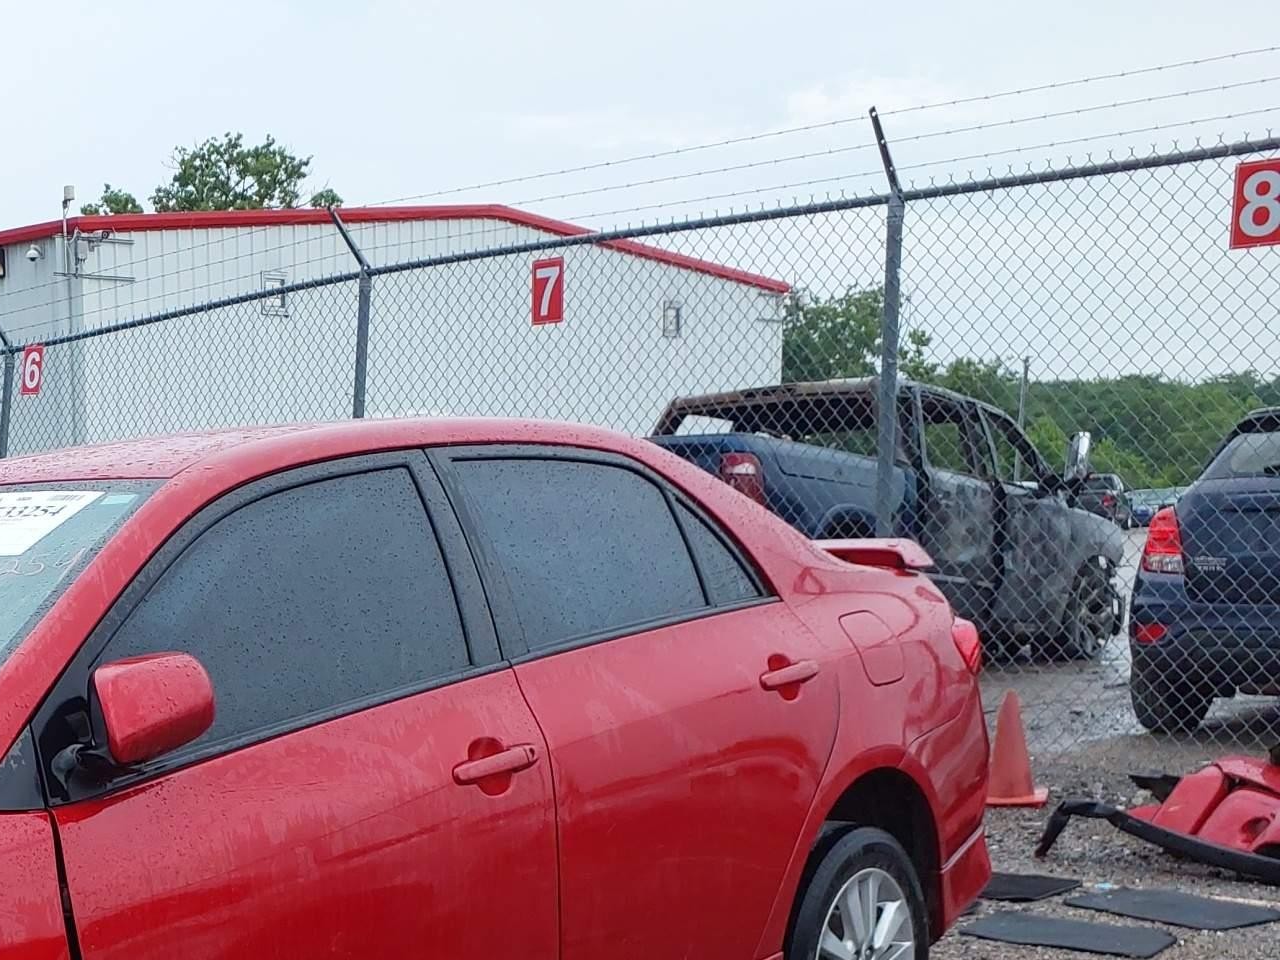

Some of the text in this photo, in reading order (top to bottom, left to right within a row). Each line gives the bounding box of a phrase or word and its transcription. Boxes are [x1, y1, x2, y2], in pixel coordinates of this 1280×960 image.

[1239, 170, 1280, 237] 8
[536, 266, 561, 316] 7
[25, 351, 40, 389] 6
